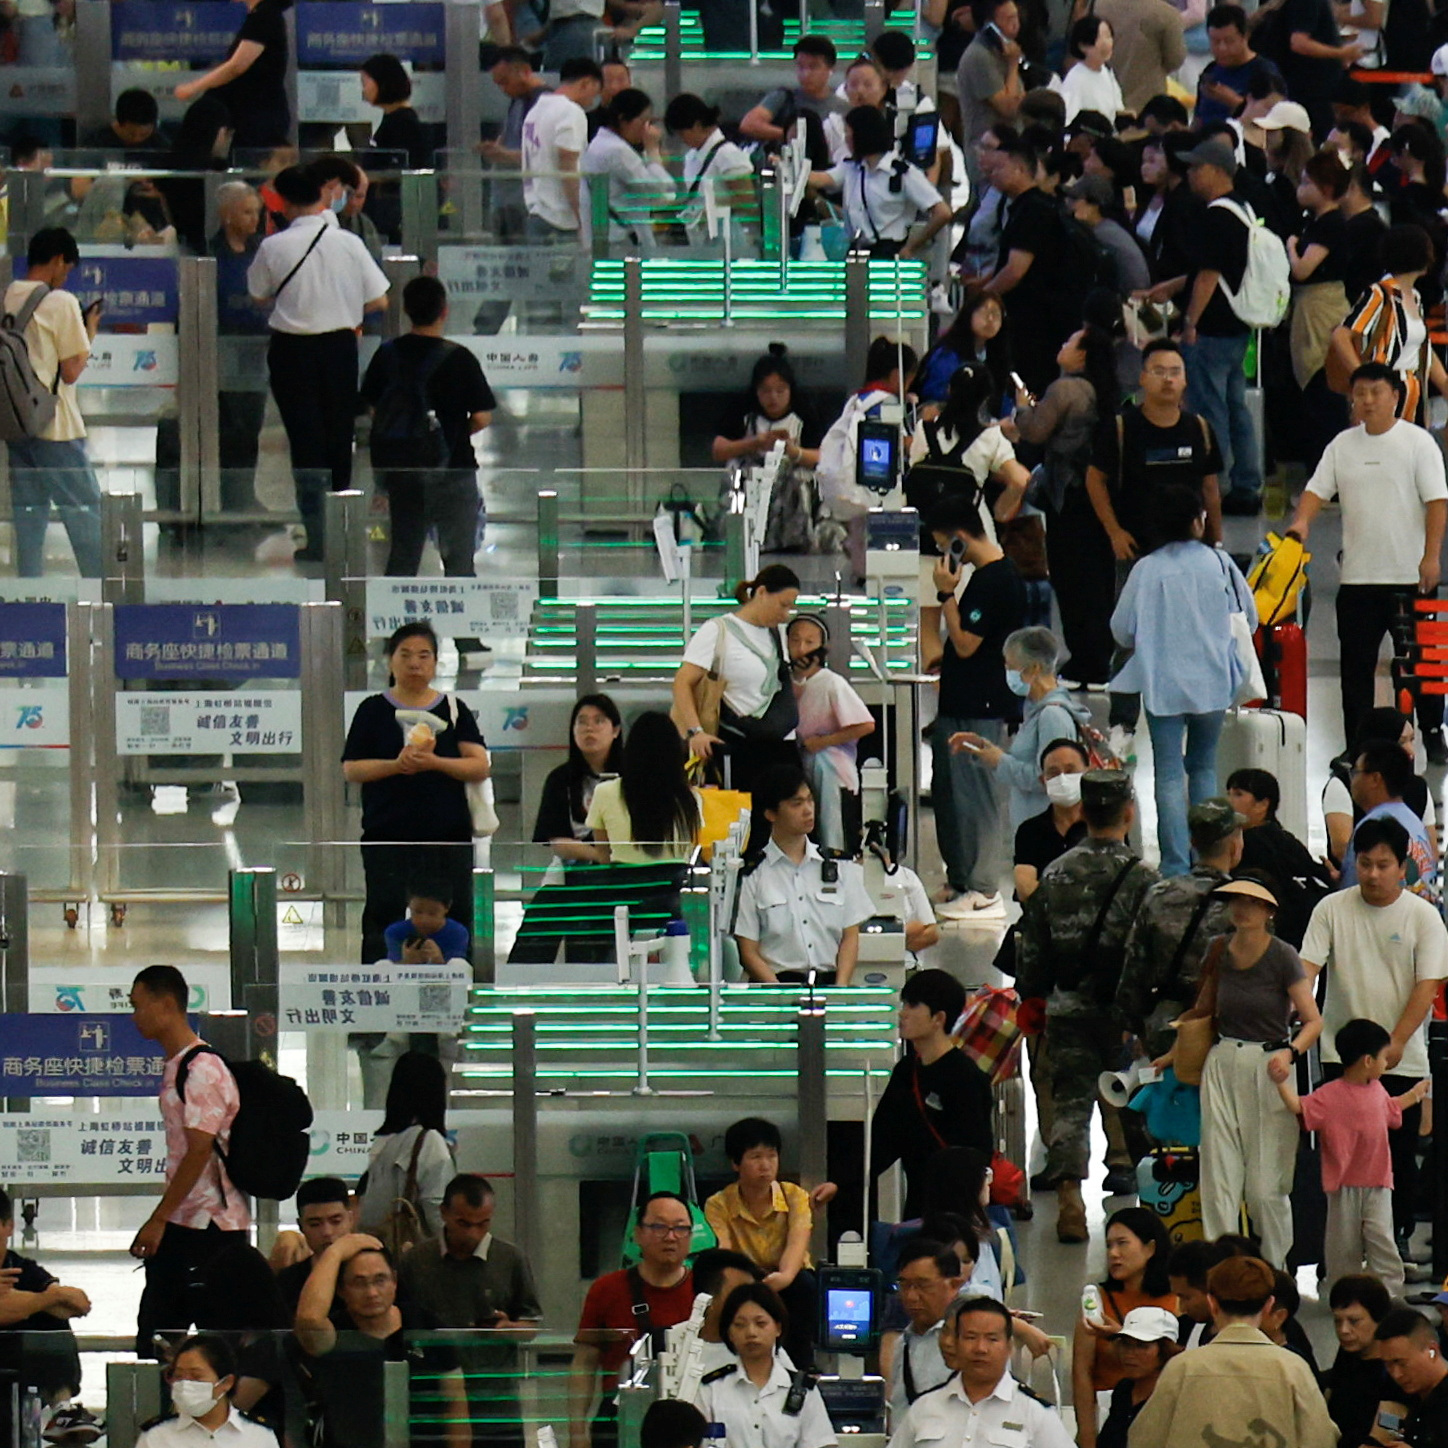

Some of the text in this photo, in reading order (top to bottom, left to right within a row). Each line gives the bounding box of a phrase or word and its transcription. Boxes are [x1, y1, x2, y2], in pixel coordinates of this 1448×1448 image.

[126, 641, 289, 661] 商务座快捷检票通道
[196, 714, 260, 729] 诚信友善
[229, 731, 294, 746] 文明出行
[3, 1056, 165, 1077] 商务座快捷检票通
[80, 1139, 153, 1155] 诚信友善
[117, 1158, 167, 1174] 文明出
